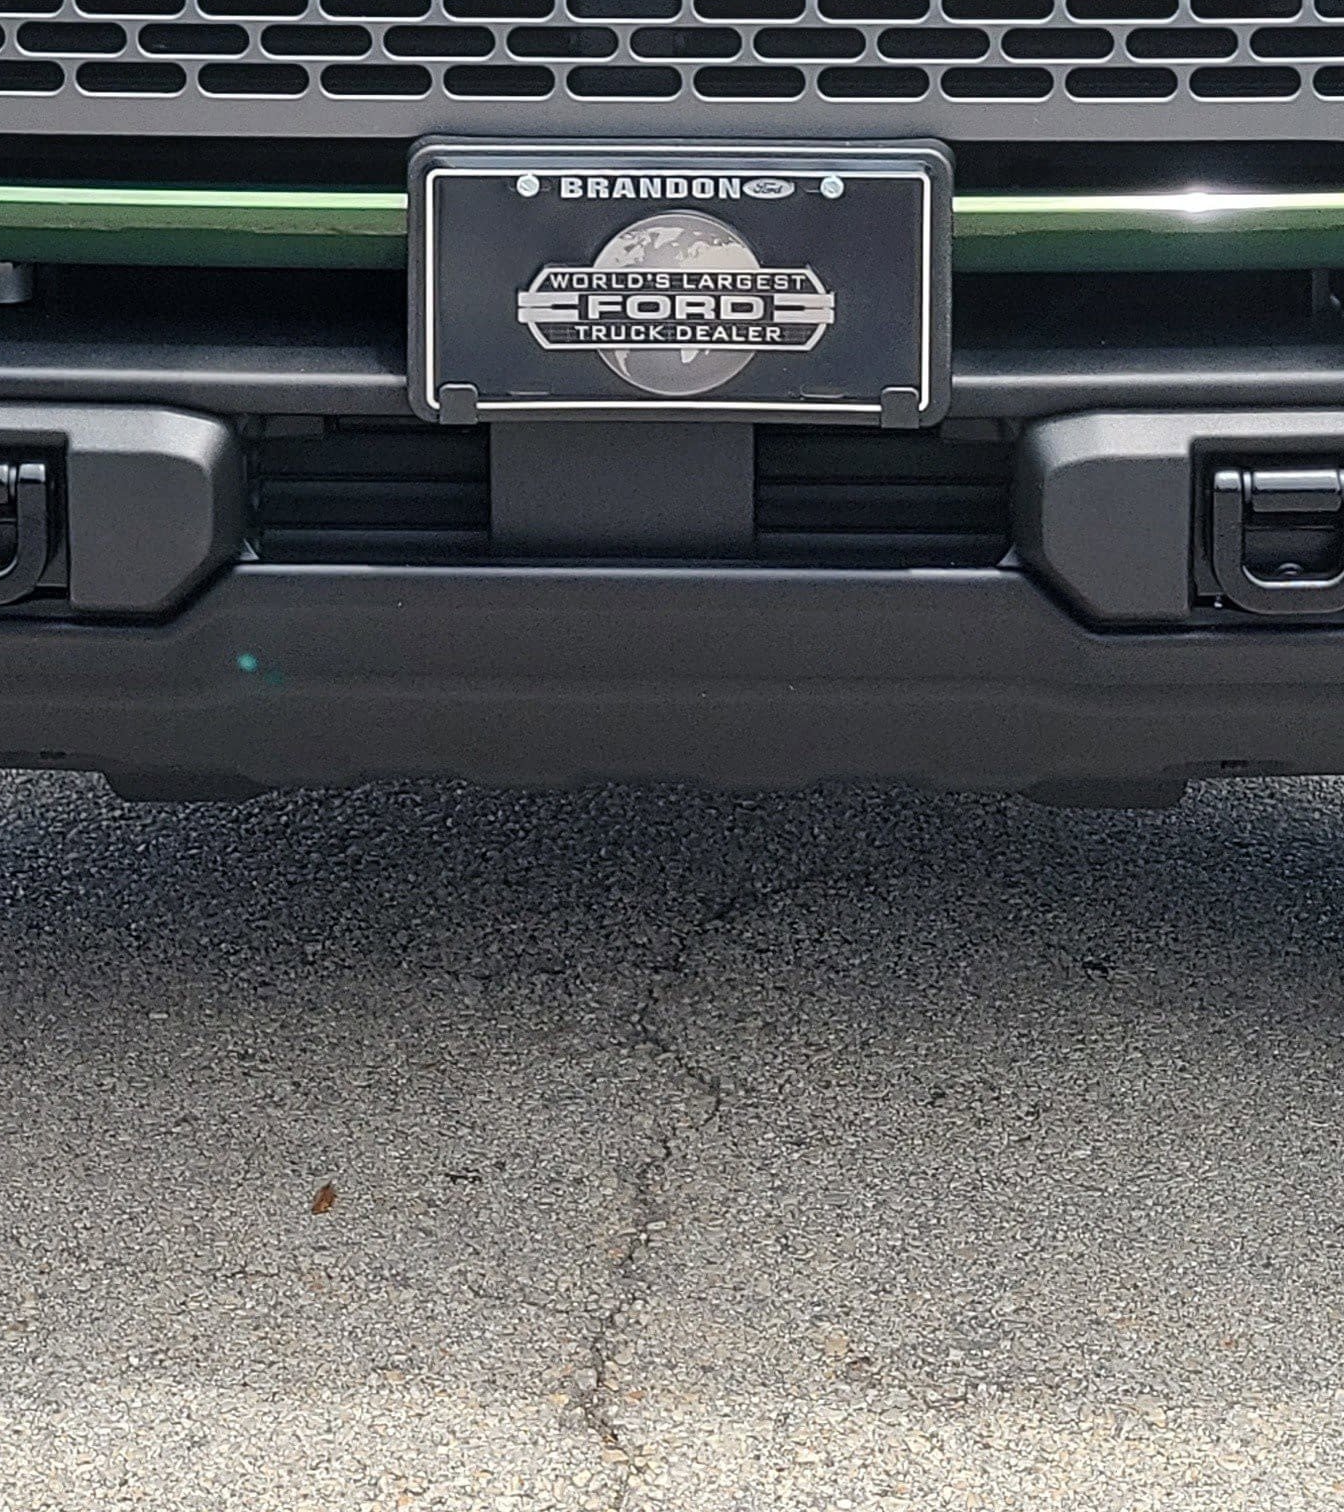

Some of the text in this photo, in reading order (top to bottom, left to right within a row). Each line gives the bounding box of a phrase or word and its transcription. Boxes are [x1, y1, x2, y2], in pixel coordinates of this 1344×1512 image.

[560, 177, 741, 199] BRANDON
[549, 273, 806, 290] WORLD'S LARGEST
[587, 294, 765, 320] FORD
[574, 324, 782, 342] TRUCK DEALER
